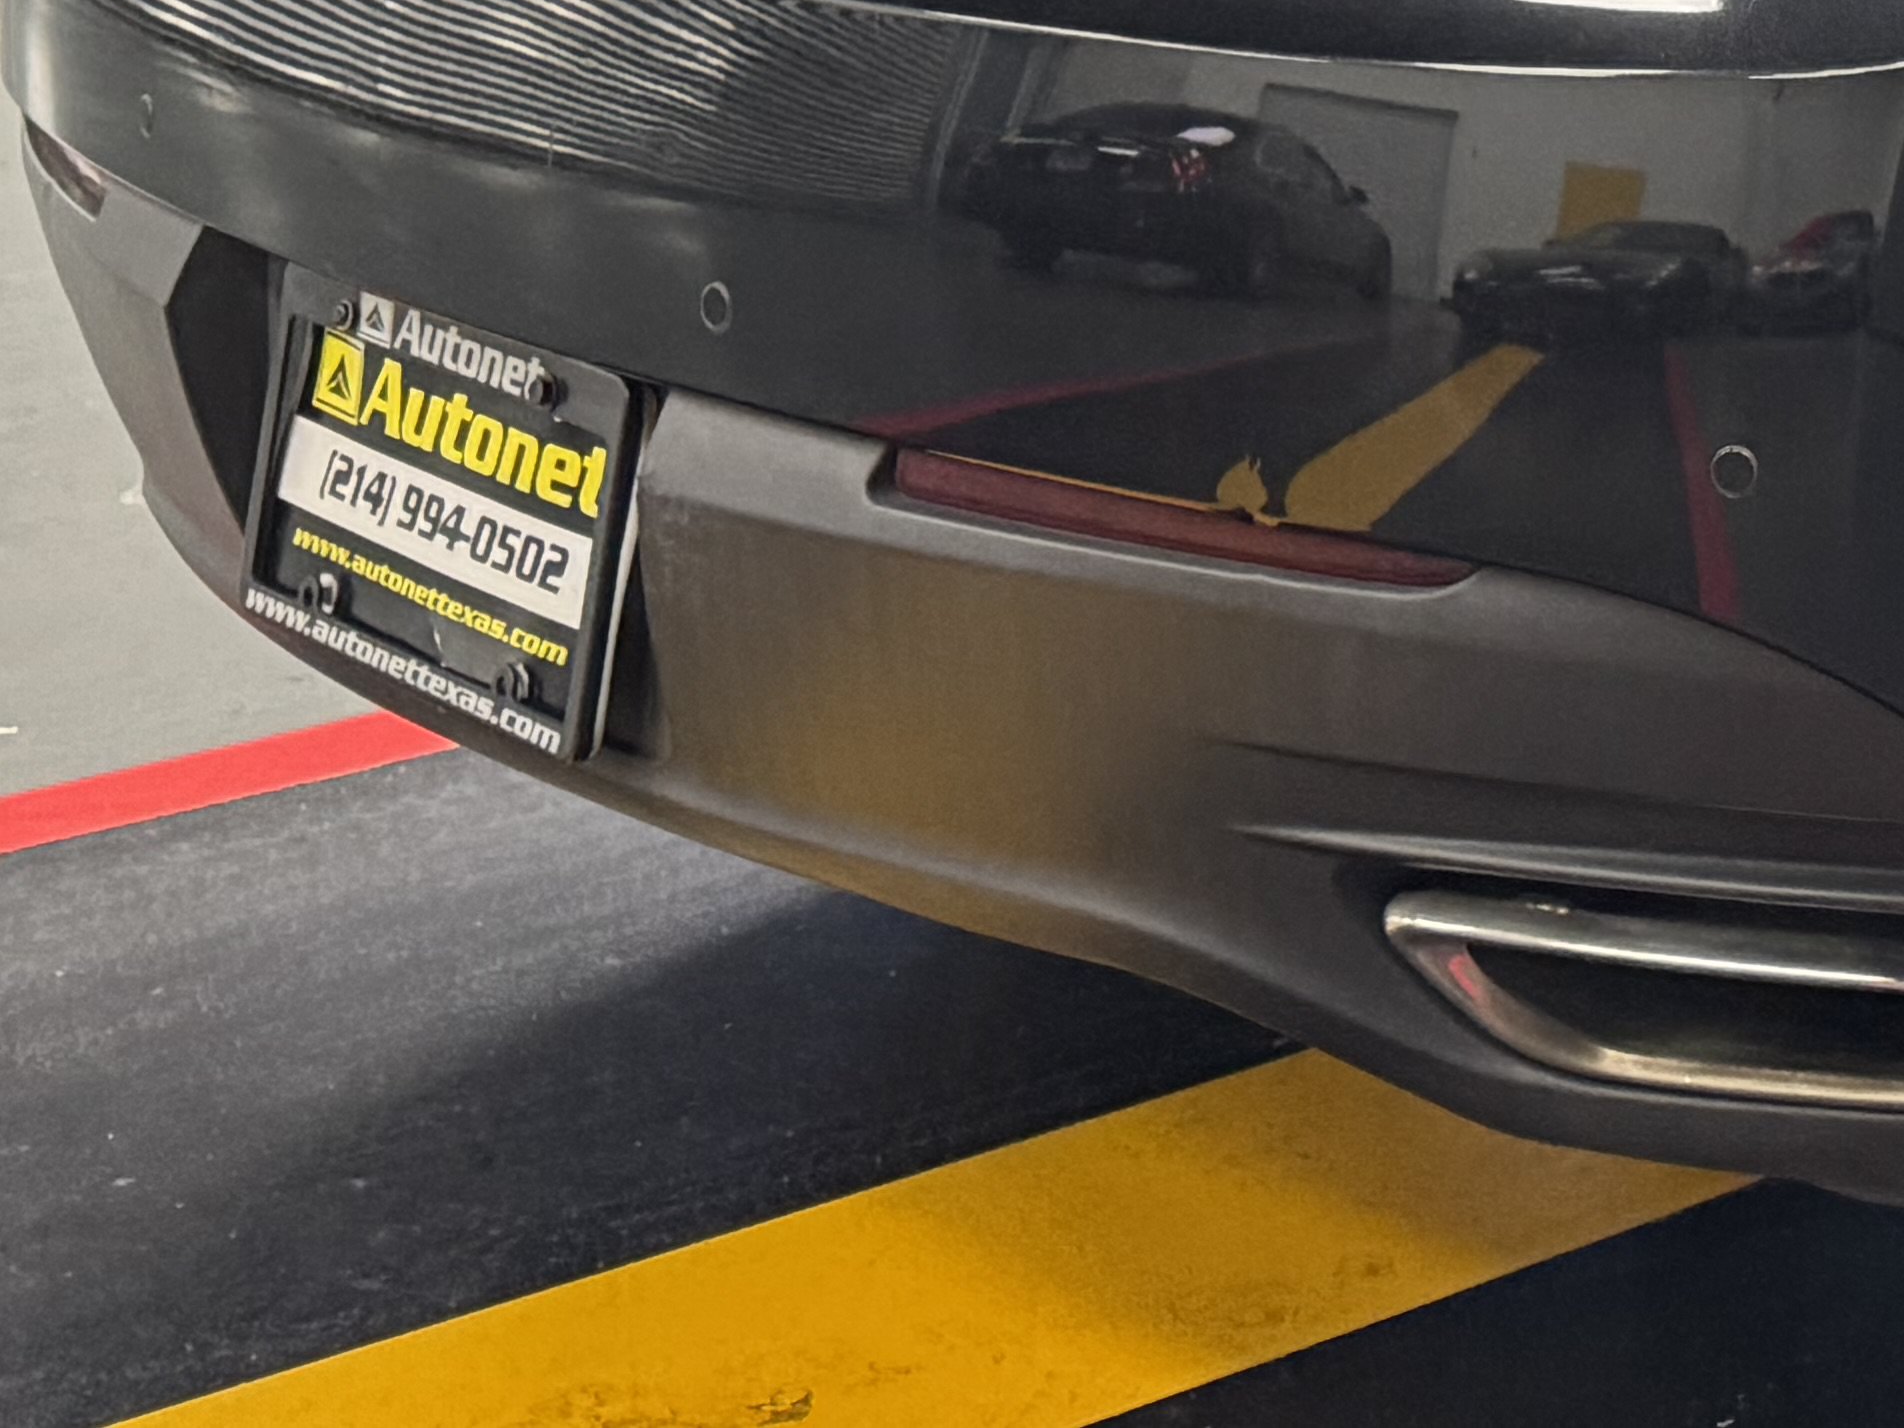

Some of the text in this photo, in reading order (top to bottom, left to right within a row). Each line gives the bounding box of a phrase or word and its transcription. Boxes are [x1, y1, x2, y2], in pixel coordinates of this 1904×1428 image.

[394, 309, 546, 401] Autonet
[360, 357, 606, 518] Autonet
[319, 448, 569, 595] (214) 994-0502
[292, 528, 569, 666] www.autonettexas.com
[245, 587, 561, 755] www.autonettexas.com
